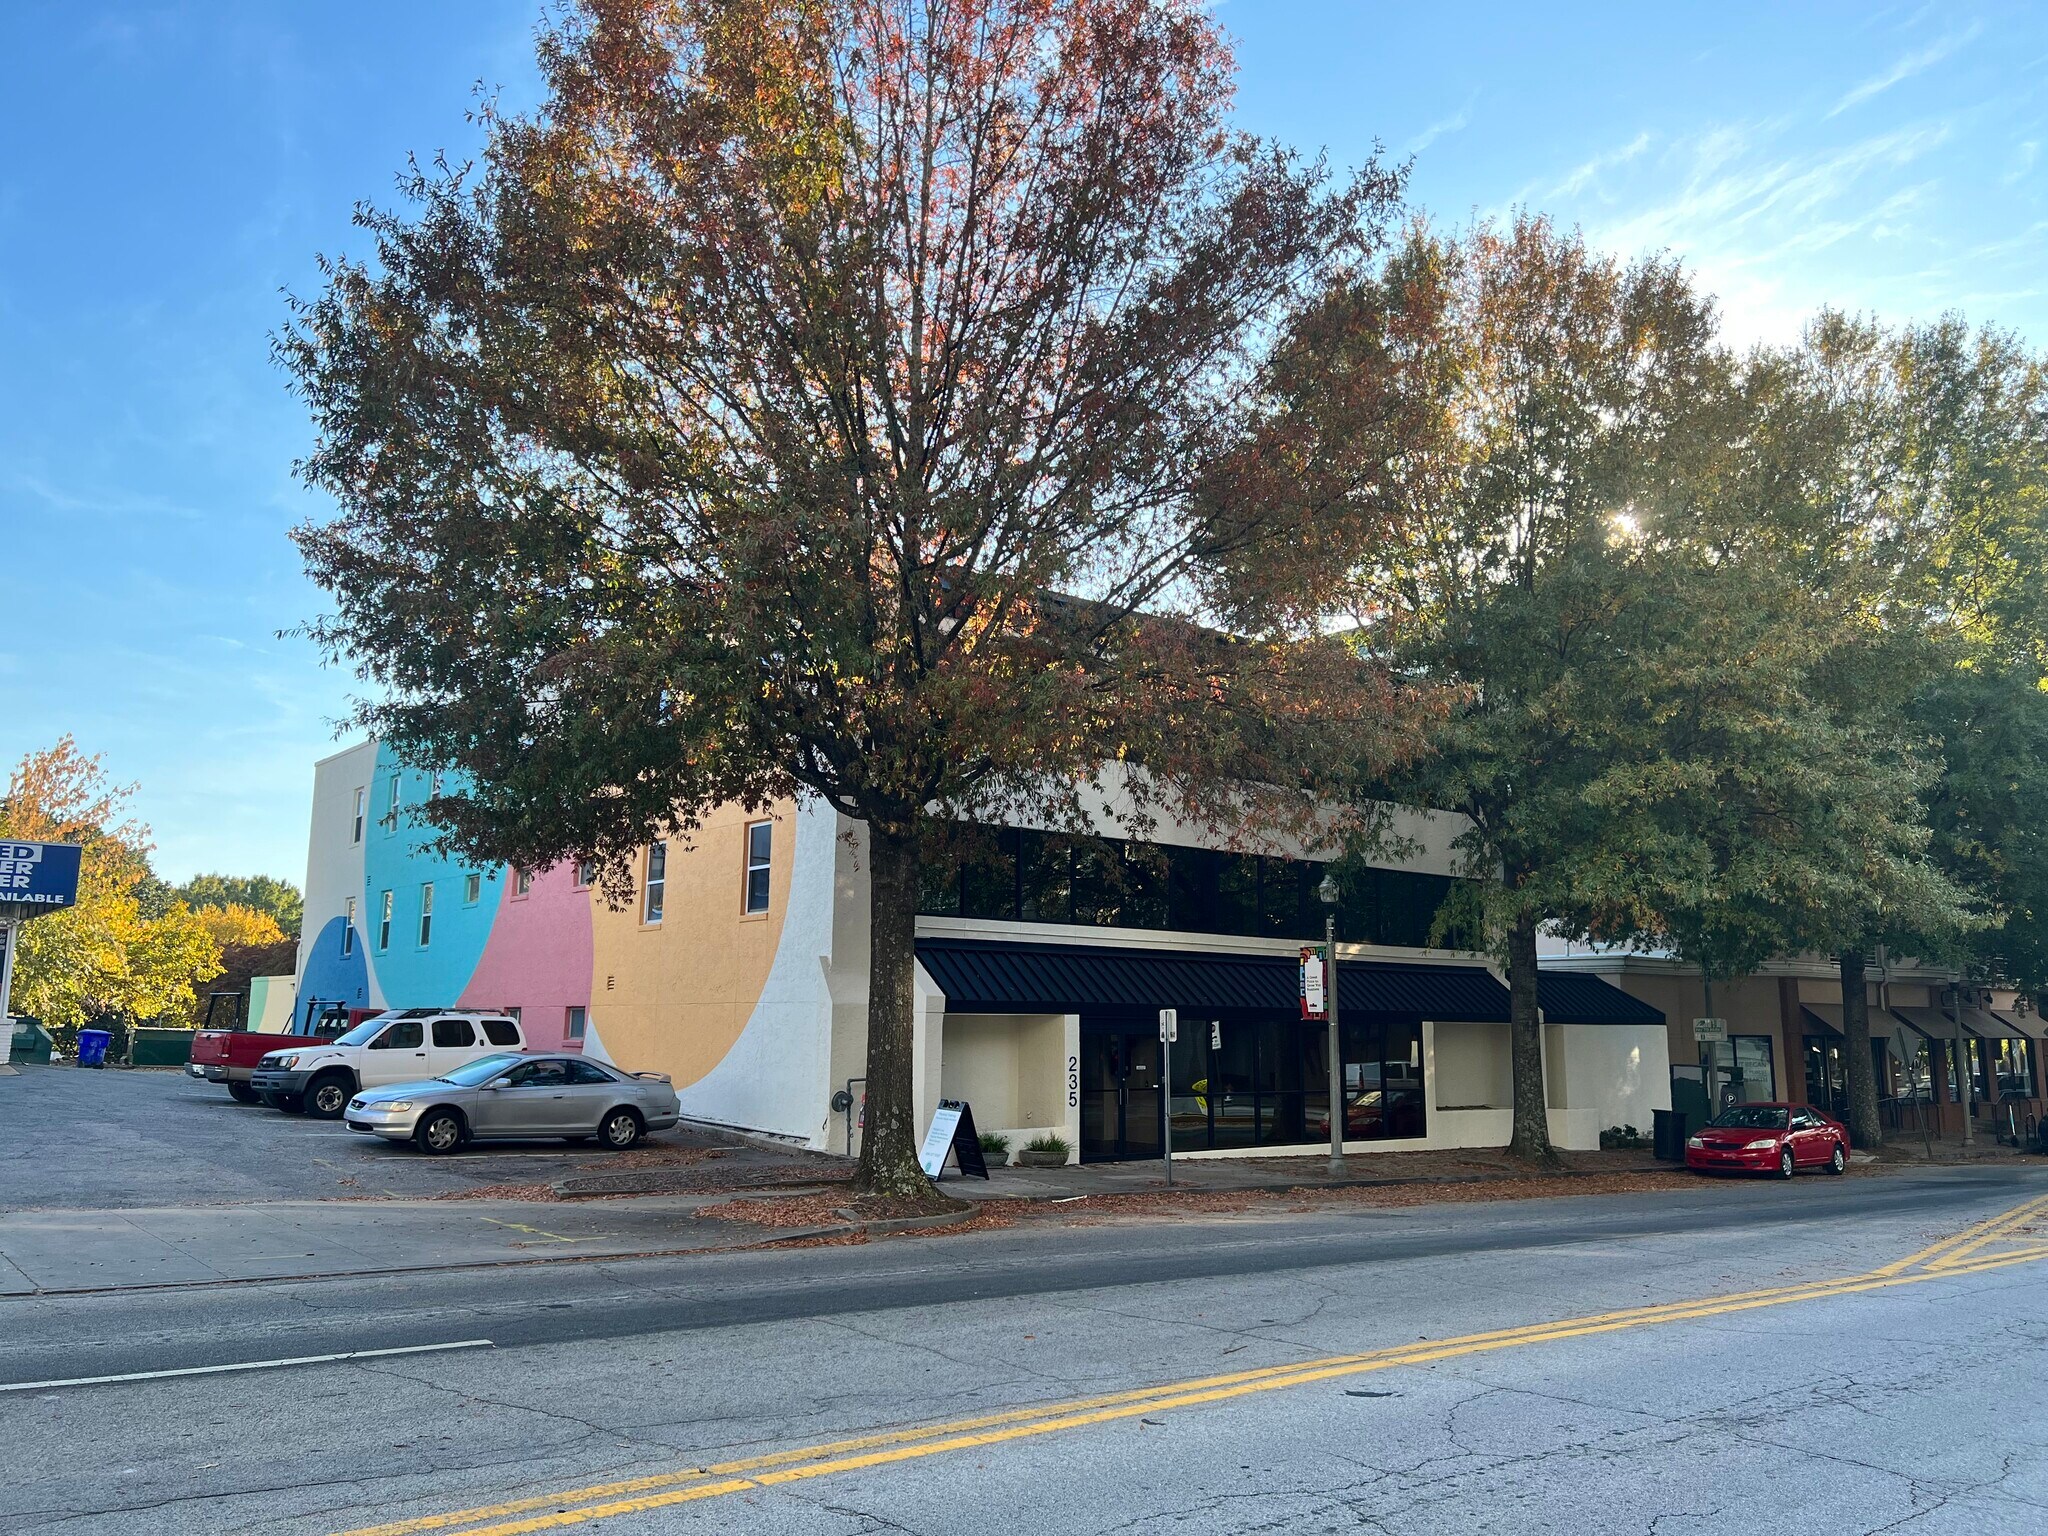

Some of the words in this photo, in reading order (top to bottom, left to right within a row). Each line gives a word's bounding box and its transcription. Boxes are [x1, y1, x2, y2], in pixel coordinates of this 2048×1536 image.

[0, 861, 33, 875] ER
[0, 875, 30, 889] ER
[1069, 1056, 1077, 1107] 235
